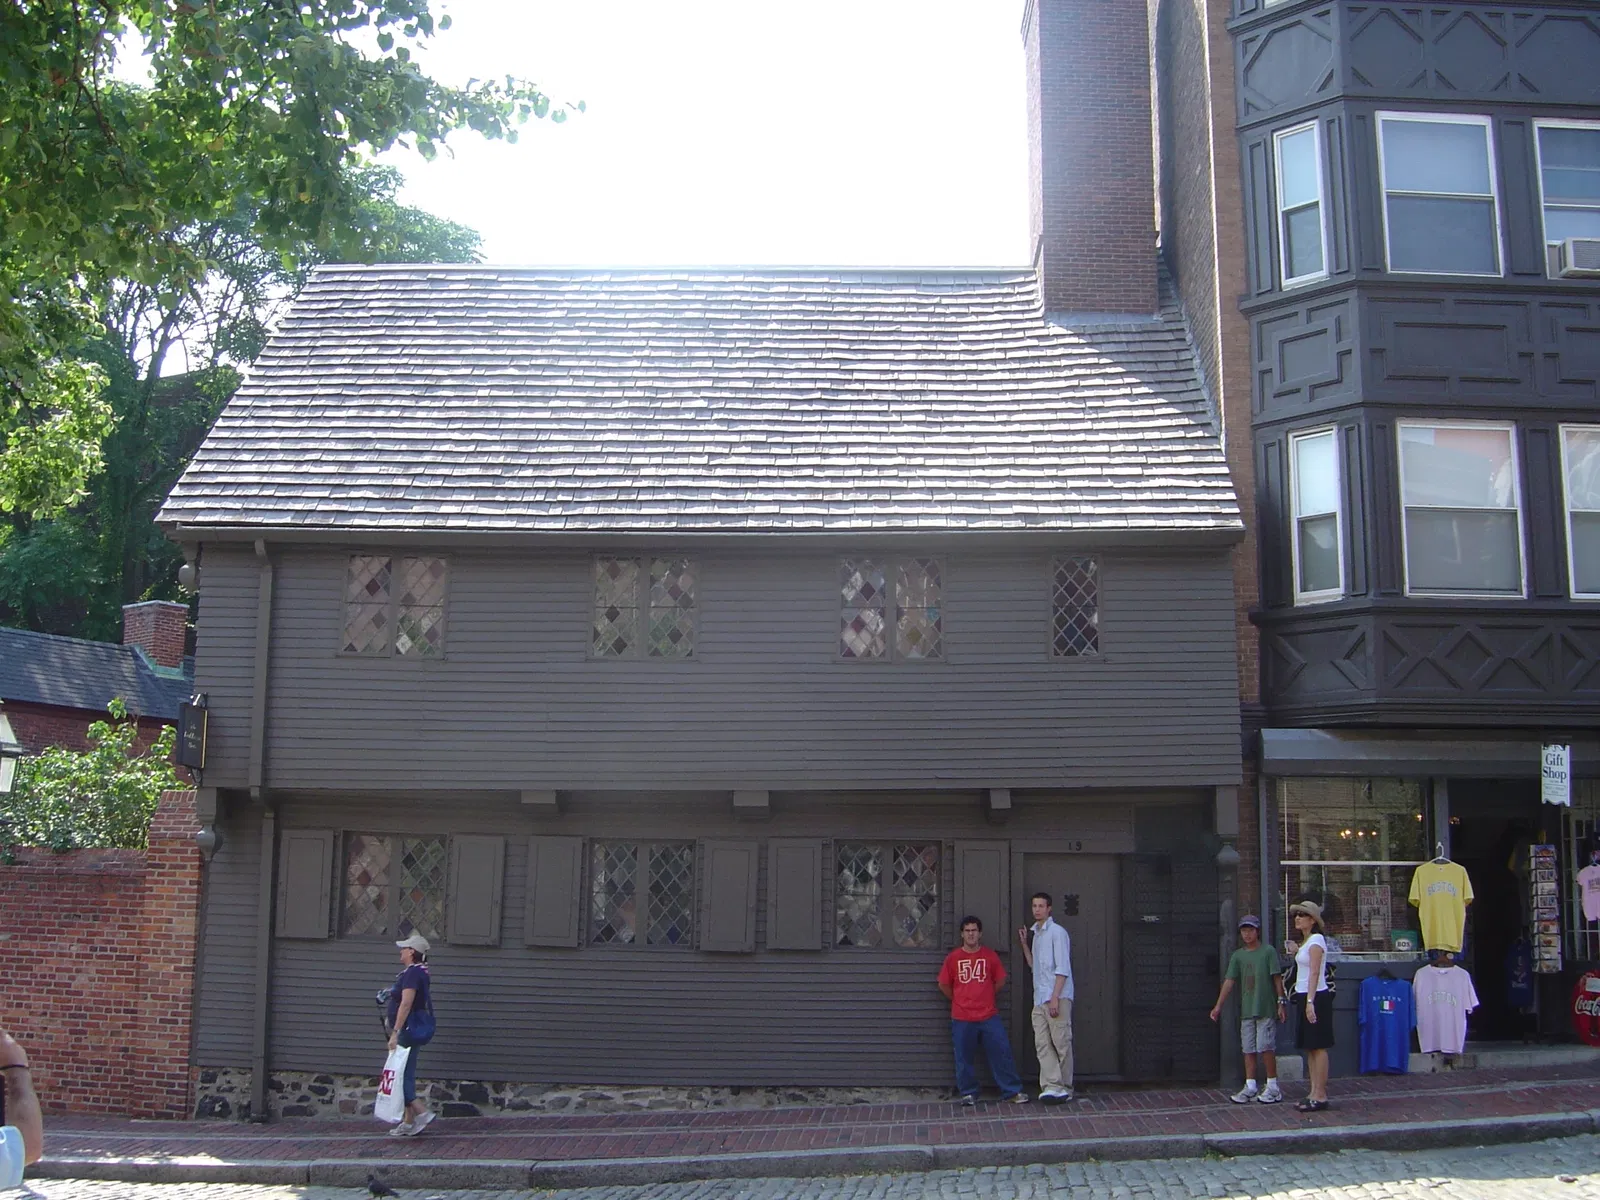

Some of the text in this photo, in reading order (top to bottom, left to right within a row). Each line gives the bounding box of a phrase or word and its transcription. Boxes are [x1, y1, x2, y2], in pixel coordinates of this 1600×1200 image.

[1545, 753, 1563, 766] Gift
[1542, 766, 1567, 783] Shop
[1068, 841, 1082, 851] 19
[1427, 881, 1457, 897] BOSTON
[958, 959, 986, 983] 54
